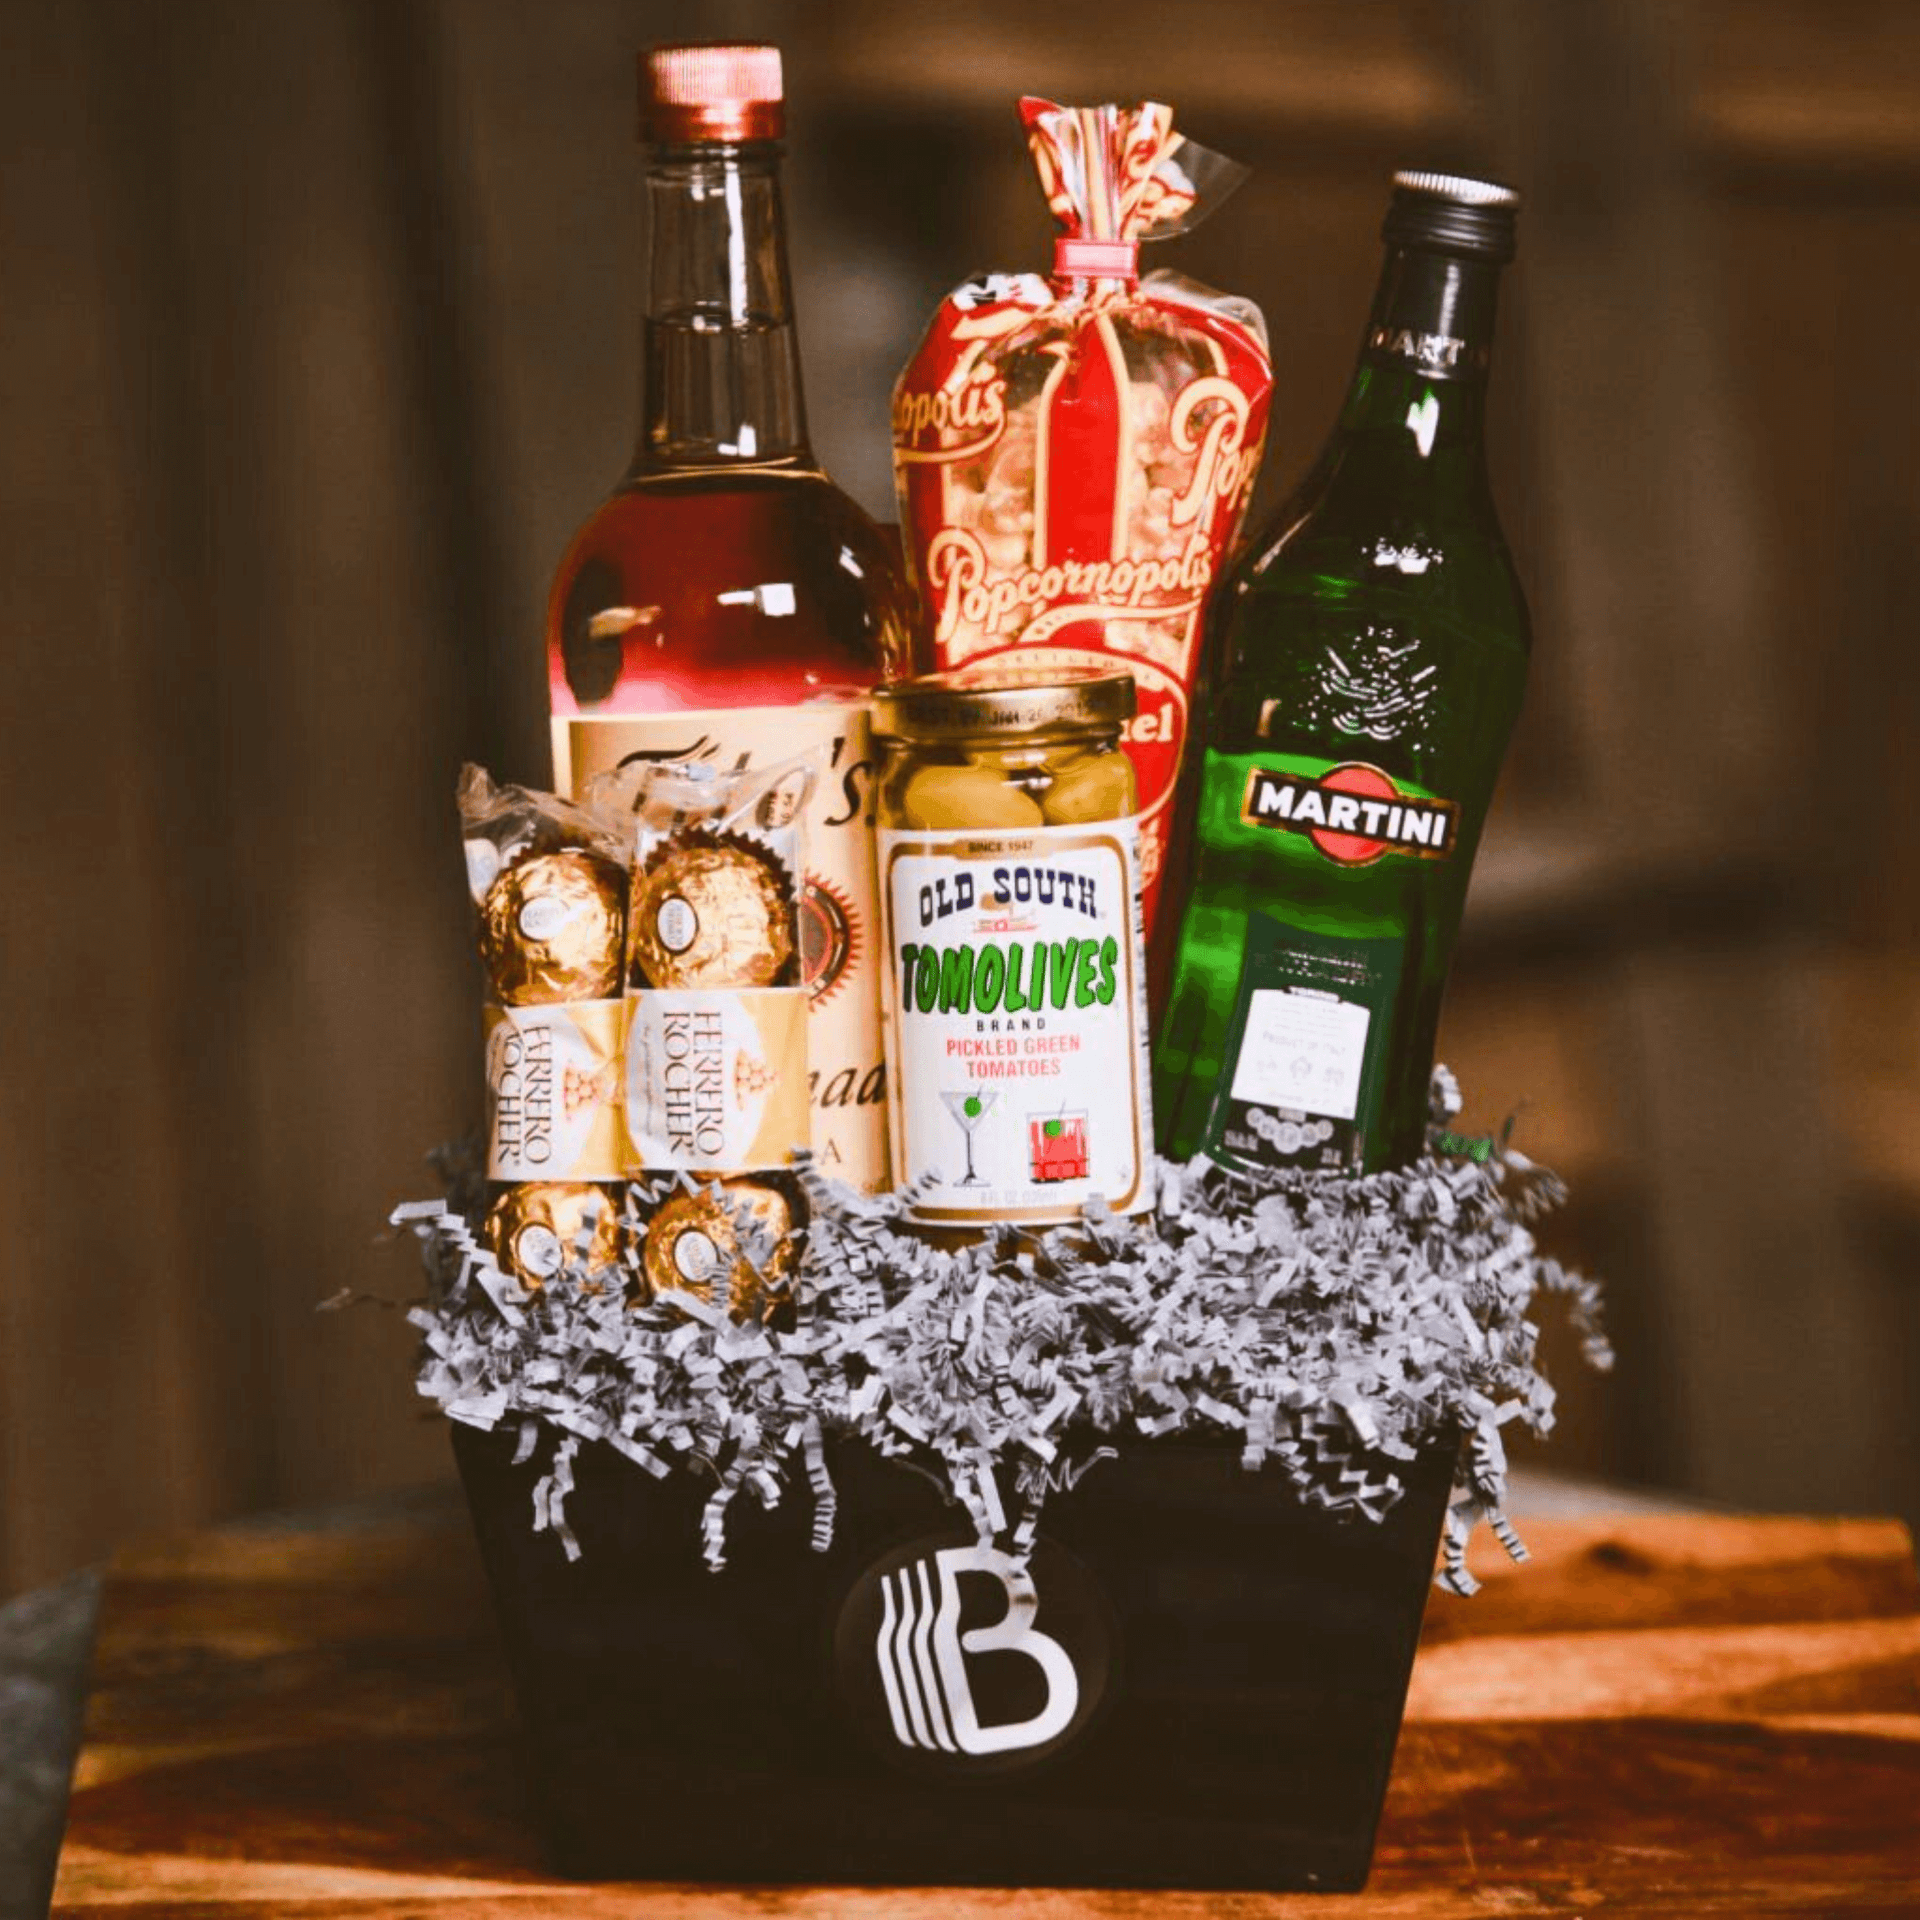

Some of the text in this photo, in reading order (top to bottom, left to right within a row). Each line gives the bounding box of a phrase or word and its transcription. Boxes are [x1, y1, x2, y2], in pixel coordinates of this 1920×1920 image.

[928, 528, 1212, 643] Popcornopolis
[968, 841, 1003, 853] SINCE
[1257, 781, 1447, 847] MARTINI
[919, 867, 1097, 928] OLD SOUTH
[901, 935, 1118, 1015] TOMOLIVES
[946, 1034, 1081, 1057] PICKLED GREEN
[976, 1017, 1046, 1032] BRAND
[521, 1025, 553, 1165] FERRERO
[662, 1011, 694, 1155] ROCHER
[693, 1011, 725, 1156] FERRERO
[966, 1058, 1061, 1078] TOMATOES
[877, 1546, 1079, 1755] B
